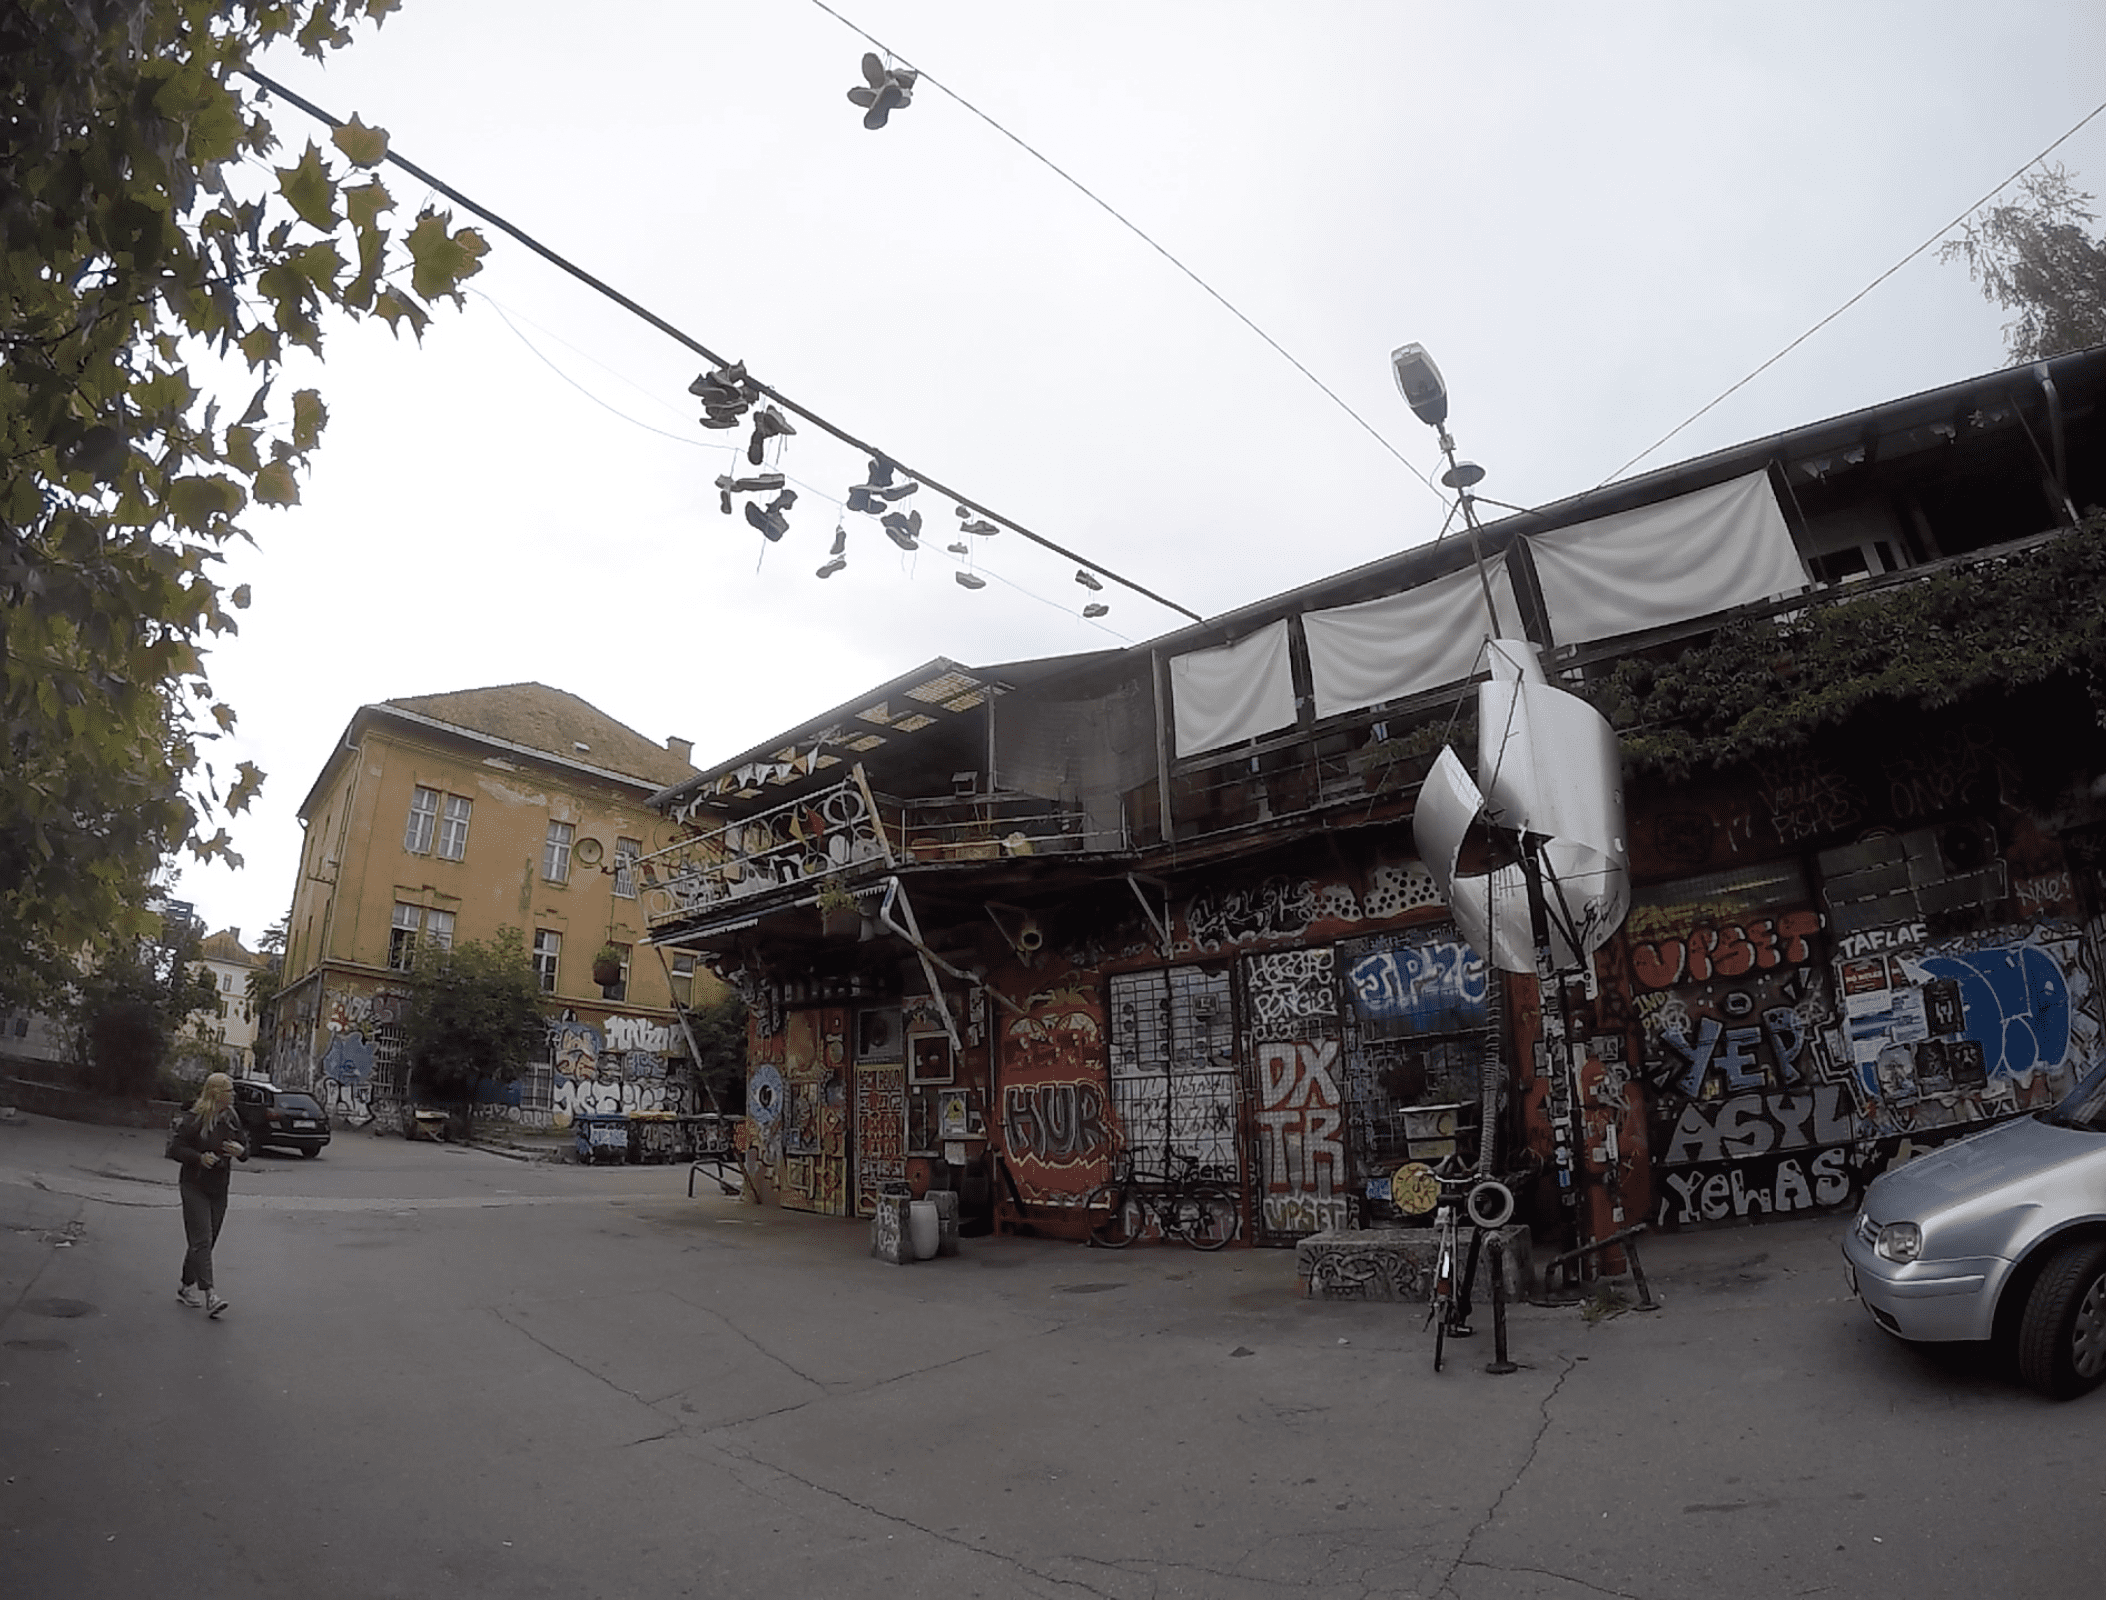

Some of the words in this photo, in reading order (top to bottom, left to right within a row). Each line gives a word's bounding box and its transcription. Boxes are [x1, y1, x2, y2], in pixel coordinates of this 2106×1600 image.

[1632, 910, 1826, 989] UPSET
[1838, 922, 1929, 959] TAFLAF
[1664, 1086, 1852, 1165] ASYL
